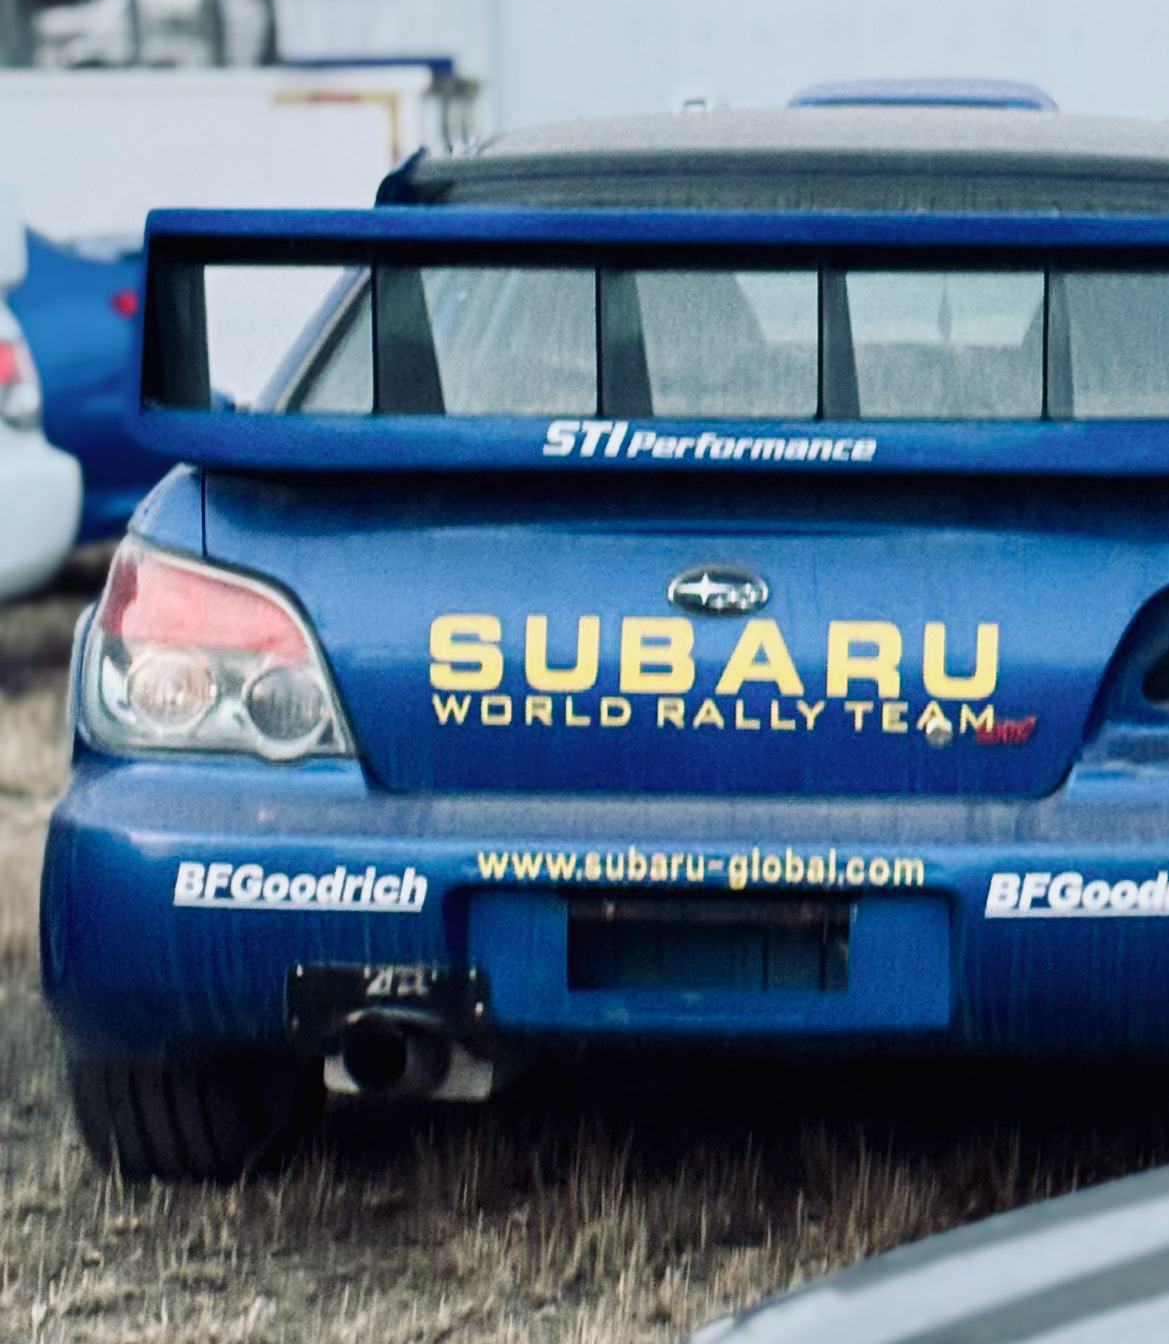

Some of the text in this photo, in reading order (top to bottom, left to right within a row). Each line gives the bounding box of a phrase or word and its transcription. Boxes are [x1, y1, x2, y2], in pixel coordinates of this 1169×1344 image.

[627, 430, 877, 462] Performance
[428, 614, 999, 699] SUBARU
[432, 693, 631, 727] WORLD
[657, 697, 825, 731] RALLY
[844, 701, 995, 734] TEAM
[174, 862, 428, 912] BFGoodrich
[478, 849, 926, 889] www.subaru-global.com
